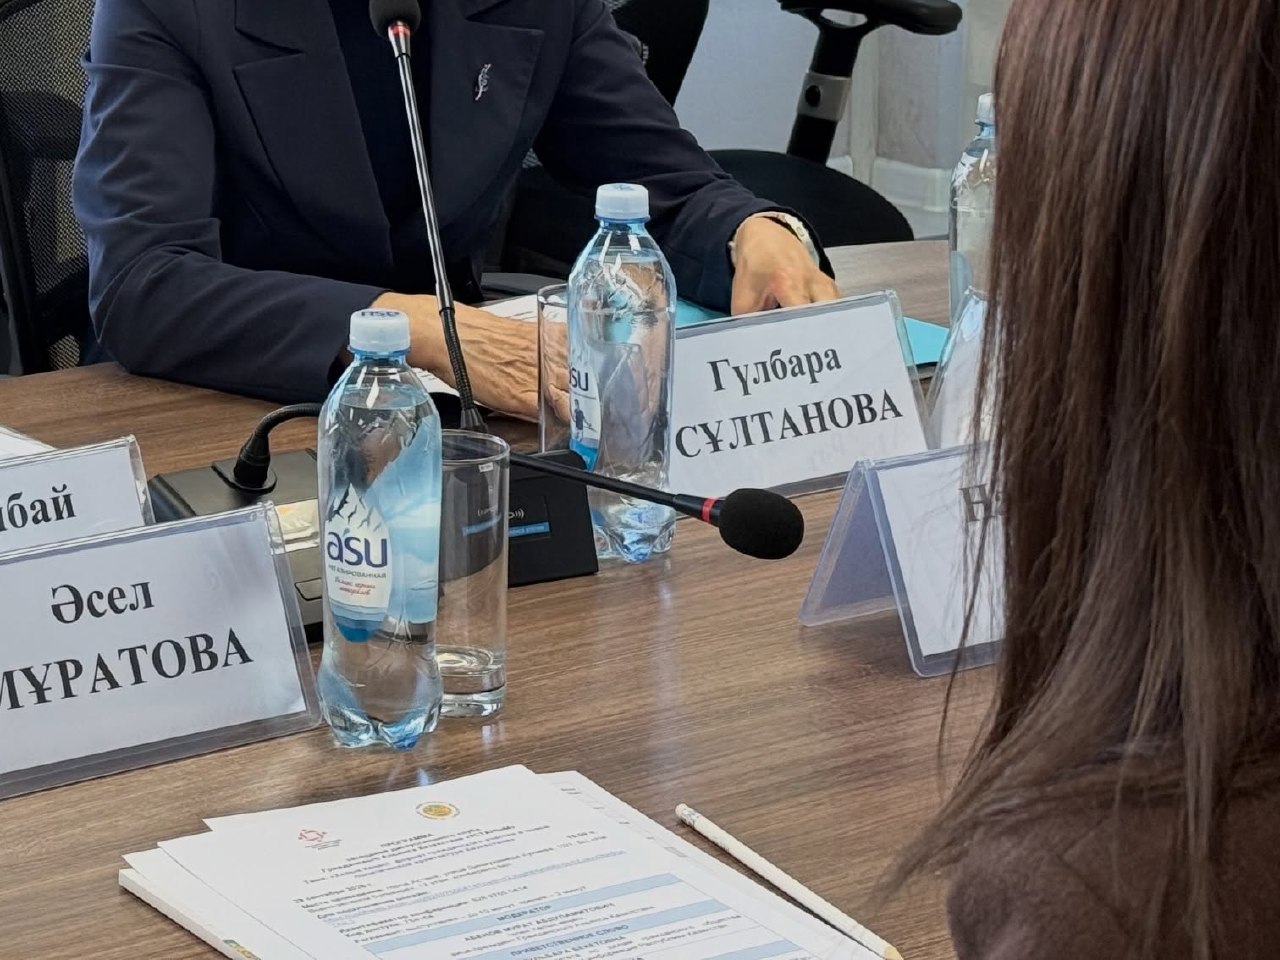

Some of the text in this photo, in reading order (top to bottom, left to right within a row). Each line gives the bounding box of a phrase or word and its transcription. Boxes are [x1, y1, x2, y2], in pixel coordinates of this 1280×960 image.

[707, 348, 842, 396] Гүлбара
[675, 389, 904, 458] СҰЛТАНОВА
[50, 581, 155, 624] Әсел
